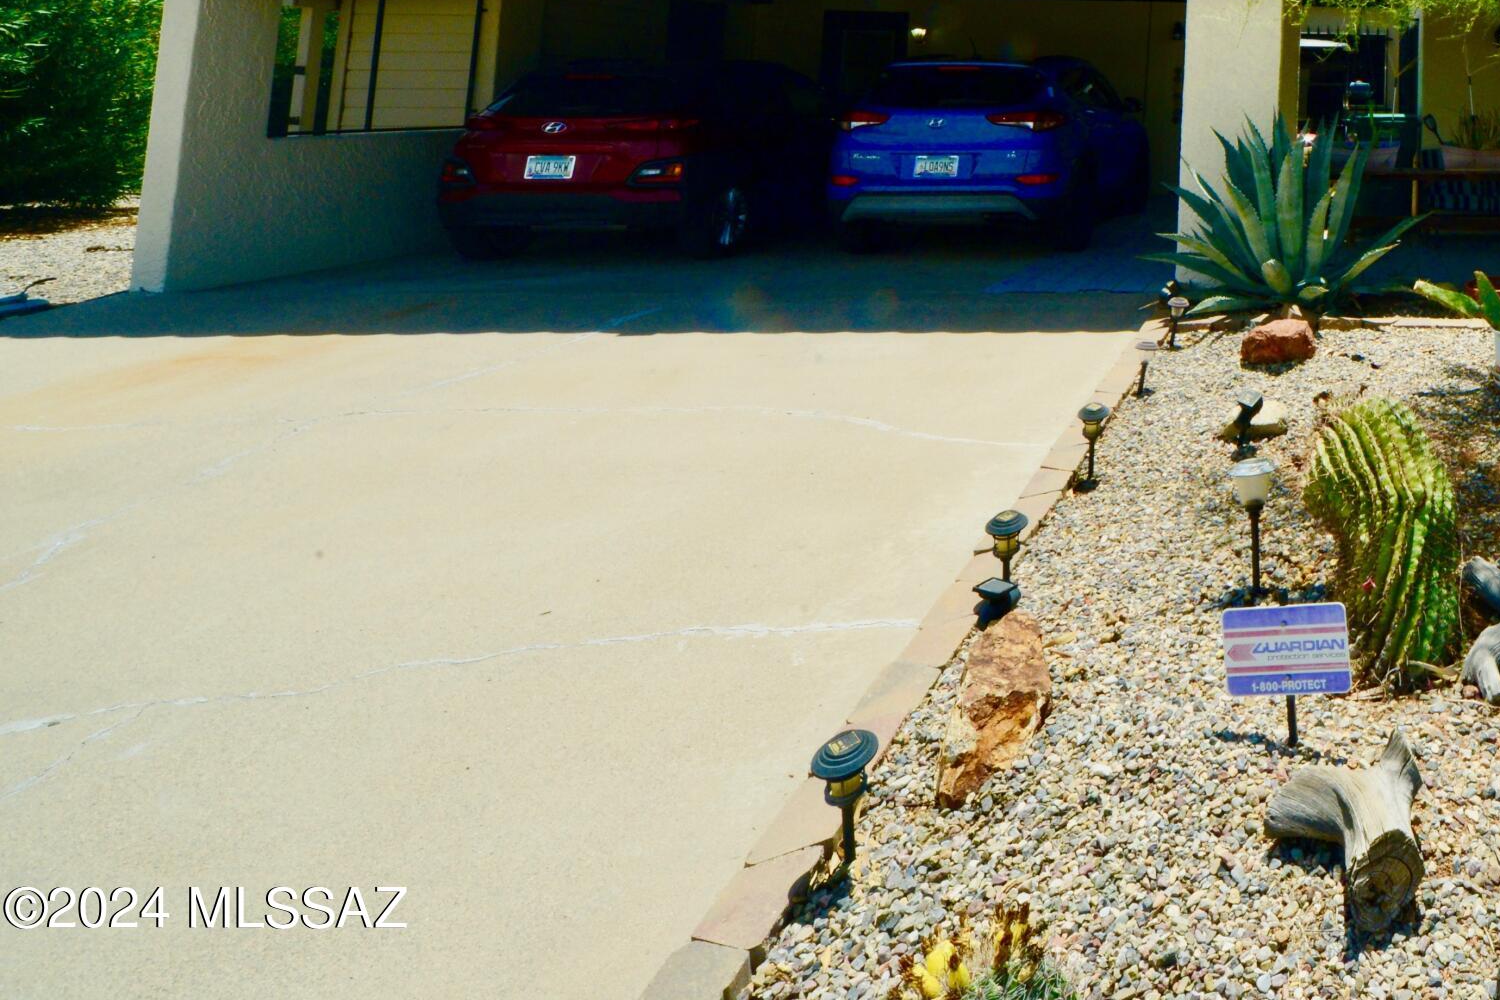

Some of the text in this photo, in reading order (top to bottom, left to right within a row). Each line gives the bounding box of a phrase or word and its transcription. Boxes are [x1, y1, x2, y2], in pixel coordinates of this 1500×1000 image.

[1252, 638, 1345, 654] GUARDIAN
[1267, 651, 1346, 661] protection services
[1251, 679, 1327, 692] 1-800-PROTECT
